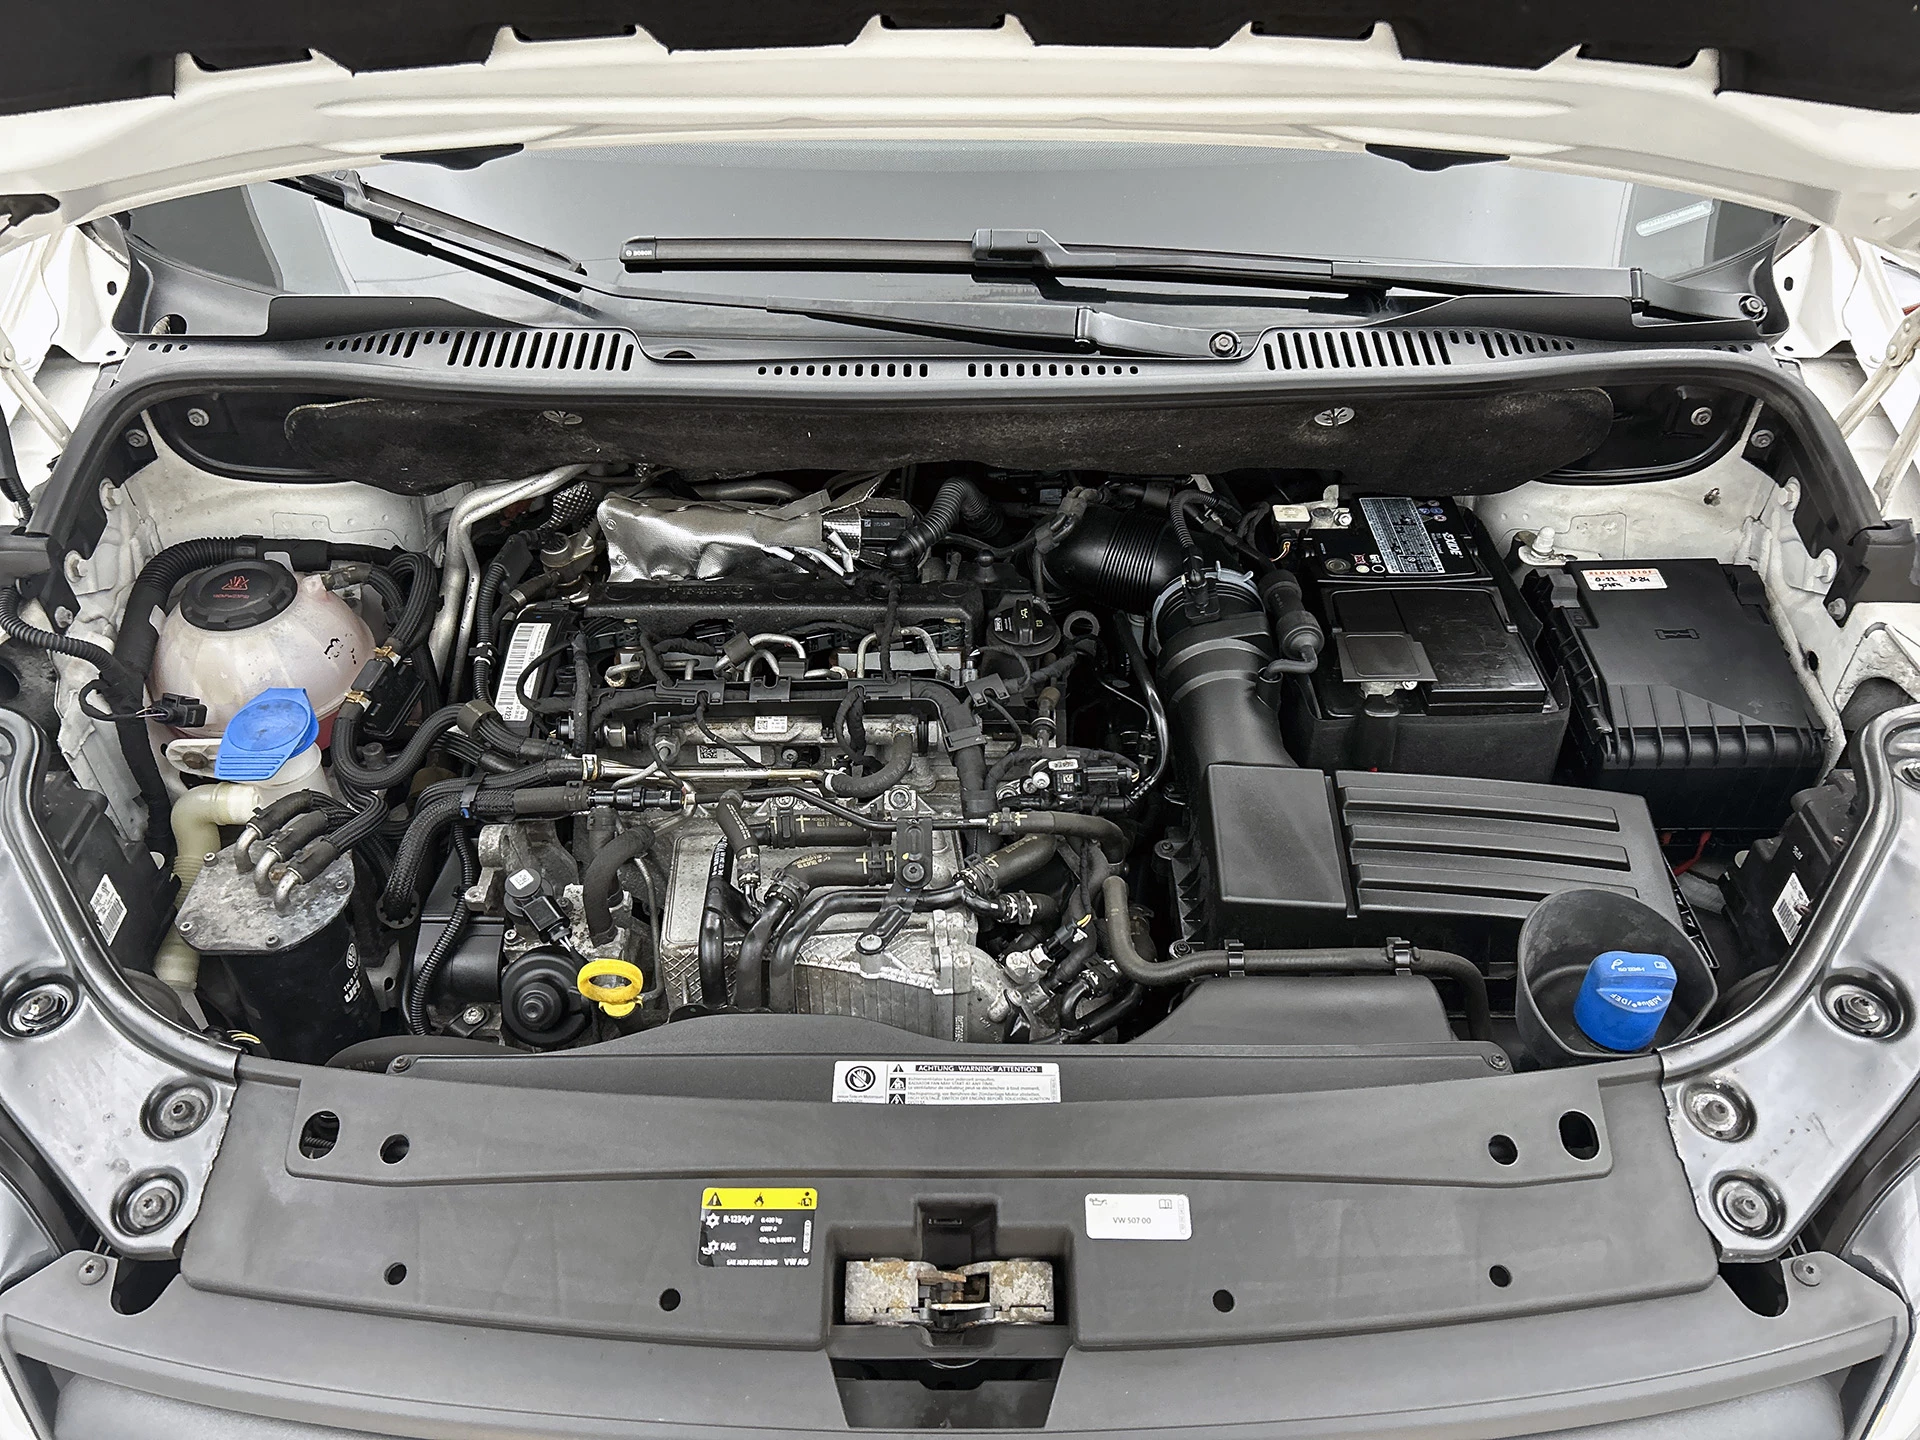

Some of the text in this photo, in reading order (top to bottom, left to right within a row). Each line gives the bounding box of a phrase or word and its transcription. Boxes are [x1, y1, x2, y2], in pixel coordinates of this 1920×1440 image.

[1442, 532, 1463, 556] EXIDE
[344, 979, 361, 1003] UFI
[723, 1215, 755, 1225] R-1234yf
[720, 1242, 736, 1251] PAG
[784, 1257, 809, 1266] VW AG
